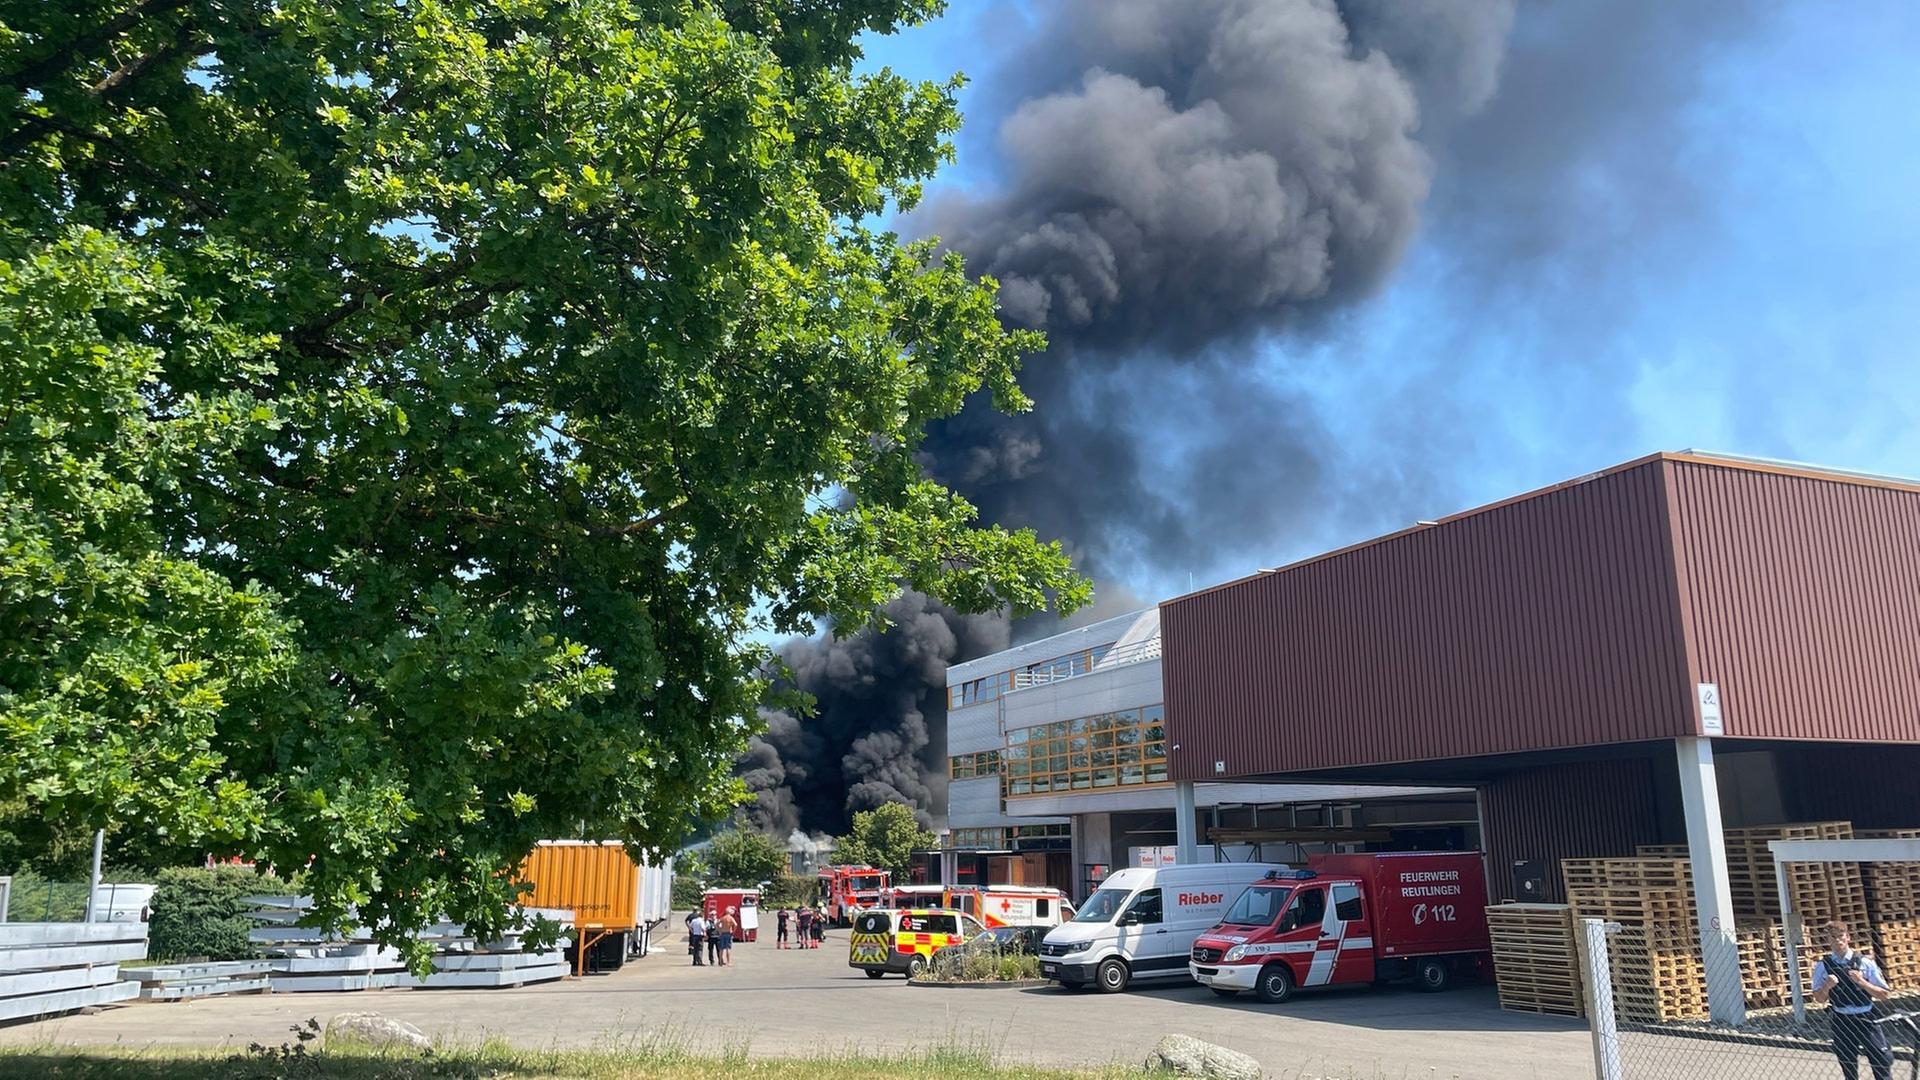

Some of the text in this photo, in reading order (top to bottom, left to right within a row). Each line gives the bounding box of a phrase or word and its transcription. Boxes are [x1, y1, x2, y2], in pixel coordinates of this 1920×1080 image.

[1400, 870, 1459, 883] FEUERWEHR
[1401, 884, 1461, 897] REUTLINGEN
[1178, 892, 1224, 905] Rieber
[1431, 904, 1456, 922] 112
